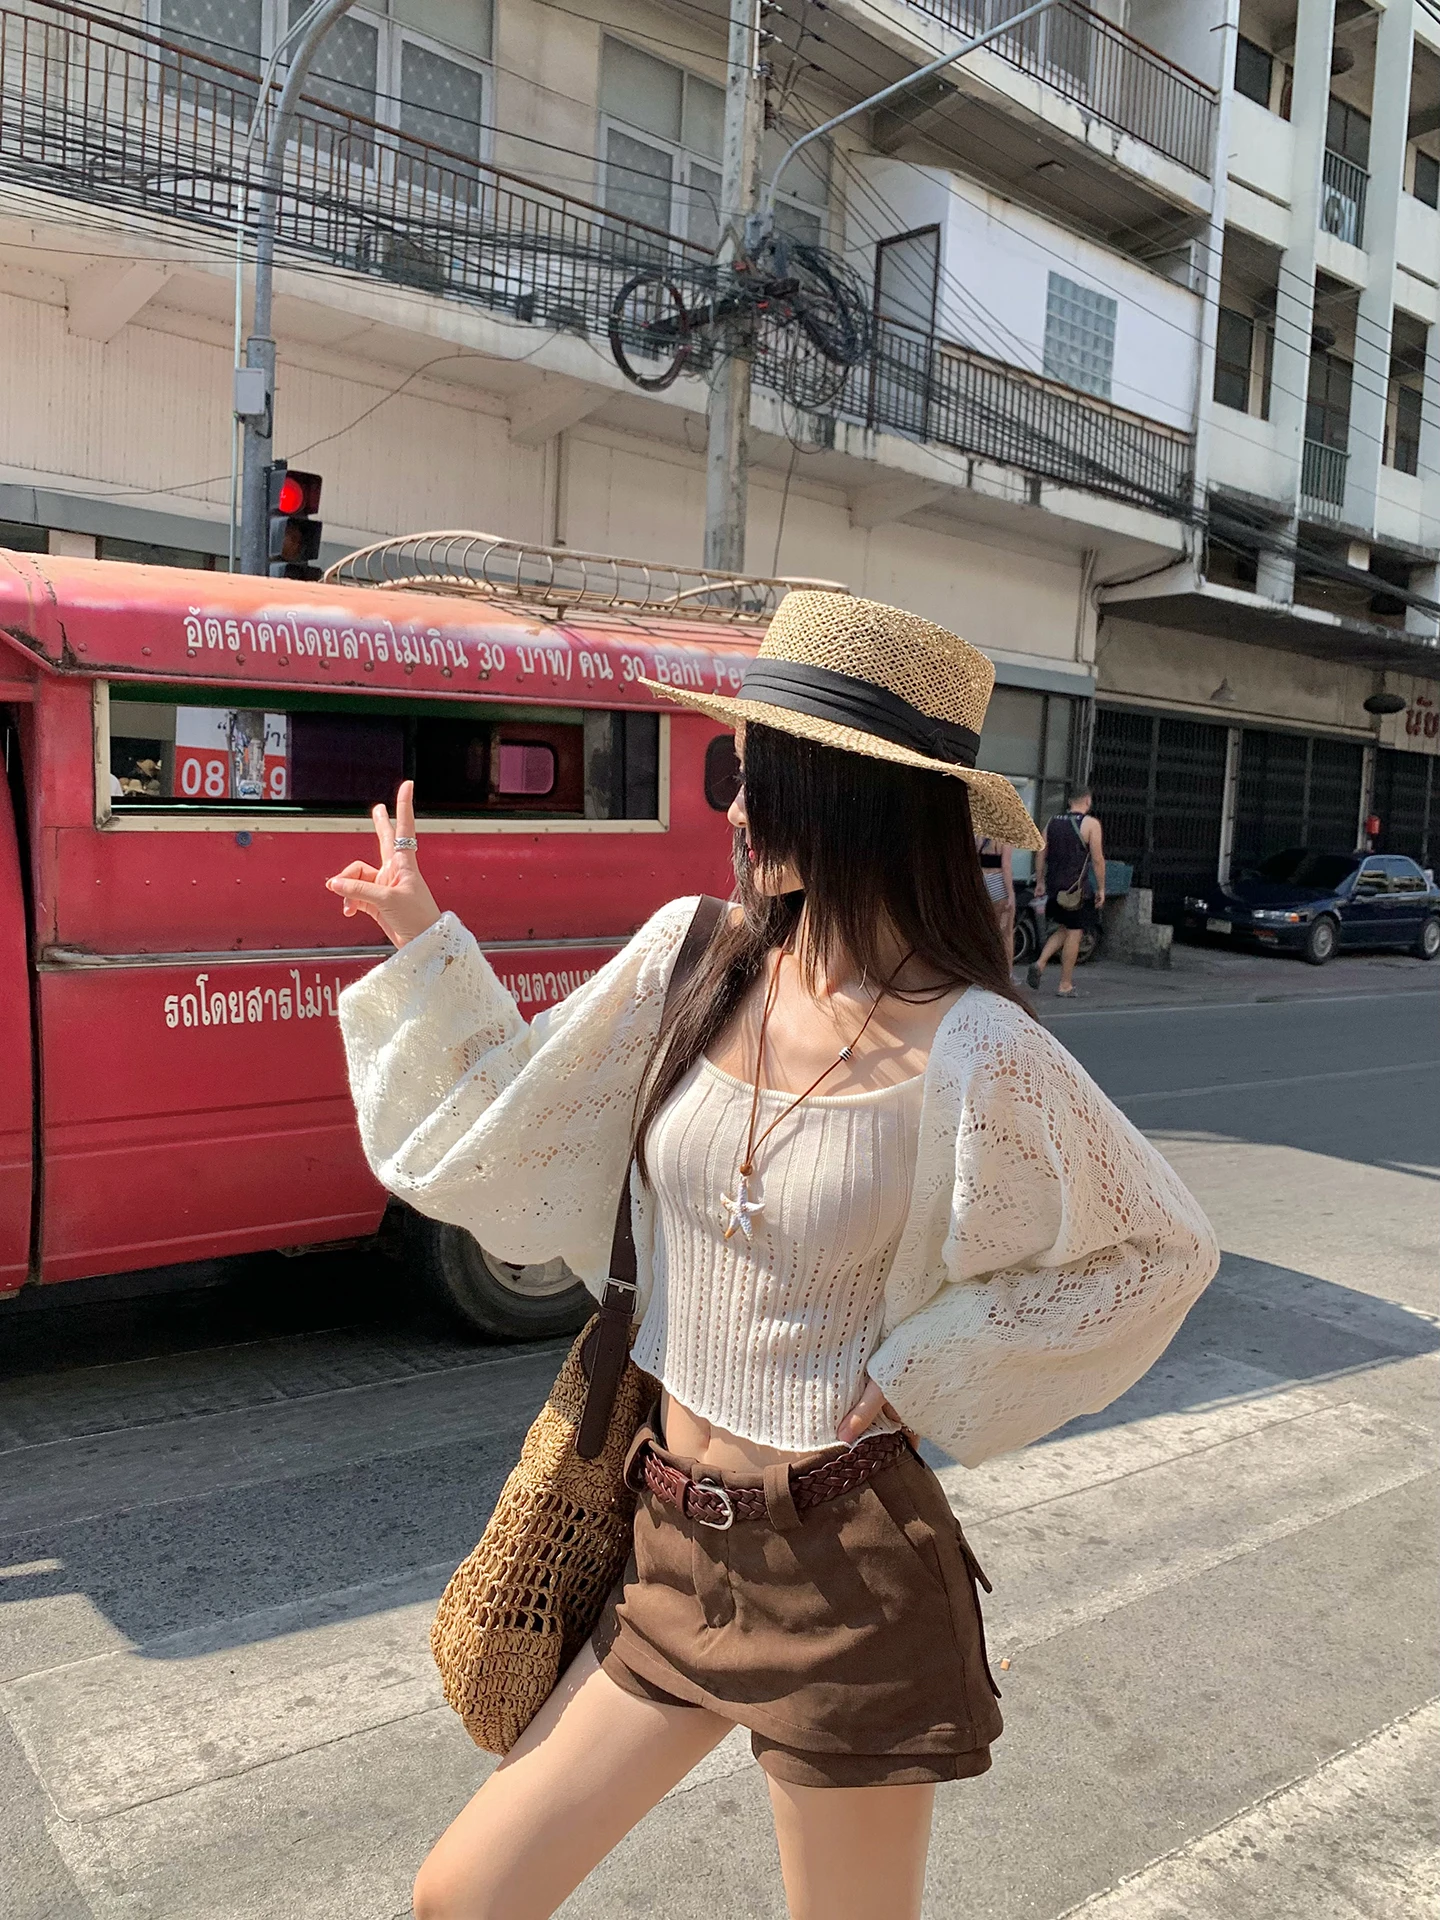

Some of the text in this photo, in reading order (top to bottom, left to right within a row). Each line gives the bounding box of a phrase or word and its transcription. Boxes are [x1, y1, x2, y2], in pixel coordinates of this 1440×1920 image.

[183, 605, 469, 669] อัตราค่าโดยสารไม่เกิน
[477, 642, 506, 672] 30
[619, 654, 646, 682] 30
[653, 654, 704, 687] Baht
[164, 968, 352, 1029] รถโดยสารไม่ป
